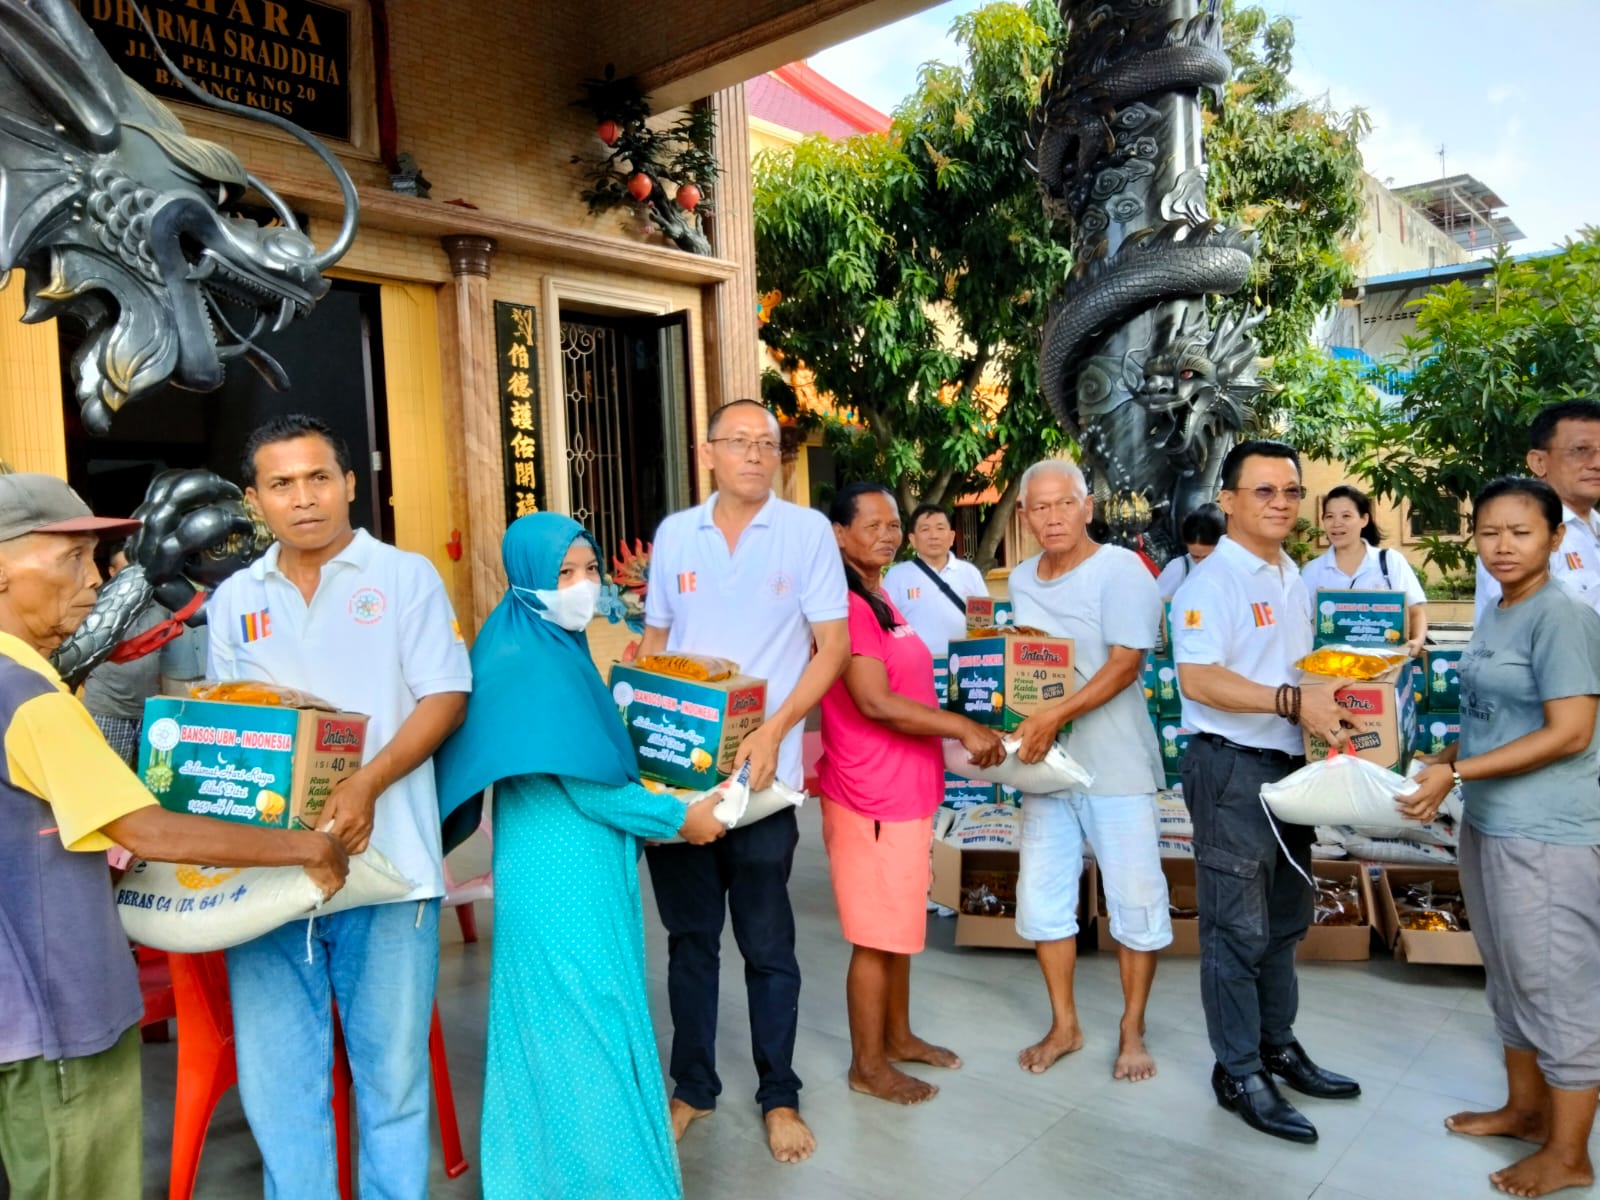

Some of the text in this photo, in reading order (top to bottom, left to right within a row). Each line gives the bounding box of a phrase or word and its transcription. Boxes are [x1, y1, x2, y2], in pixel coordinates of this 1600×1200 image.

[92, 0, 340, 86] DHARMA SRADDHA
[182, 54, 257, 87] PELITA
[263, 75, 291, 95] NO
[297, 84, 317, 102] 20
[155, 67, 294, 116] BAANG KUIS
[1033, 669, 1047, 680] 40
[1013, 684, 1038, 692] Kaldu
[1013, 692, 1038, 701] Ayam
[740, 717, 749, 729] 40
[181, 726, 216, 744] BANSOS
[216, 728, 237, 746] UBN
[241, 731, 292, 752] INDONESIA
[331, 757, 346, 771] 40
[309, 776, 330, 785] Rasa
[117, 888, 156, 911] BERAS
[156, 896, 172, 912] C4
